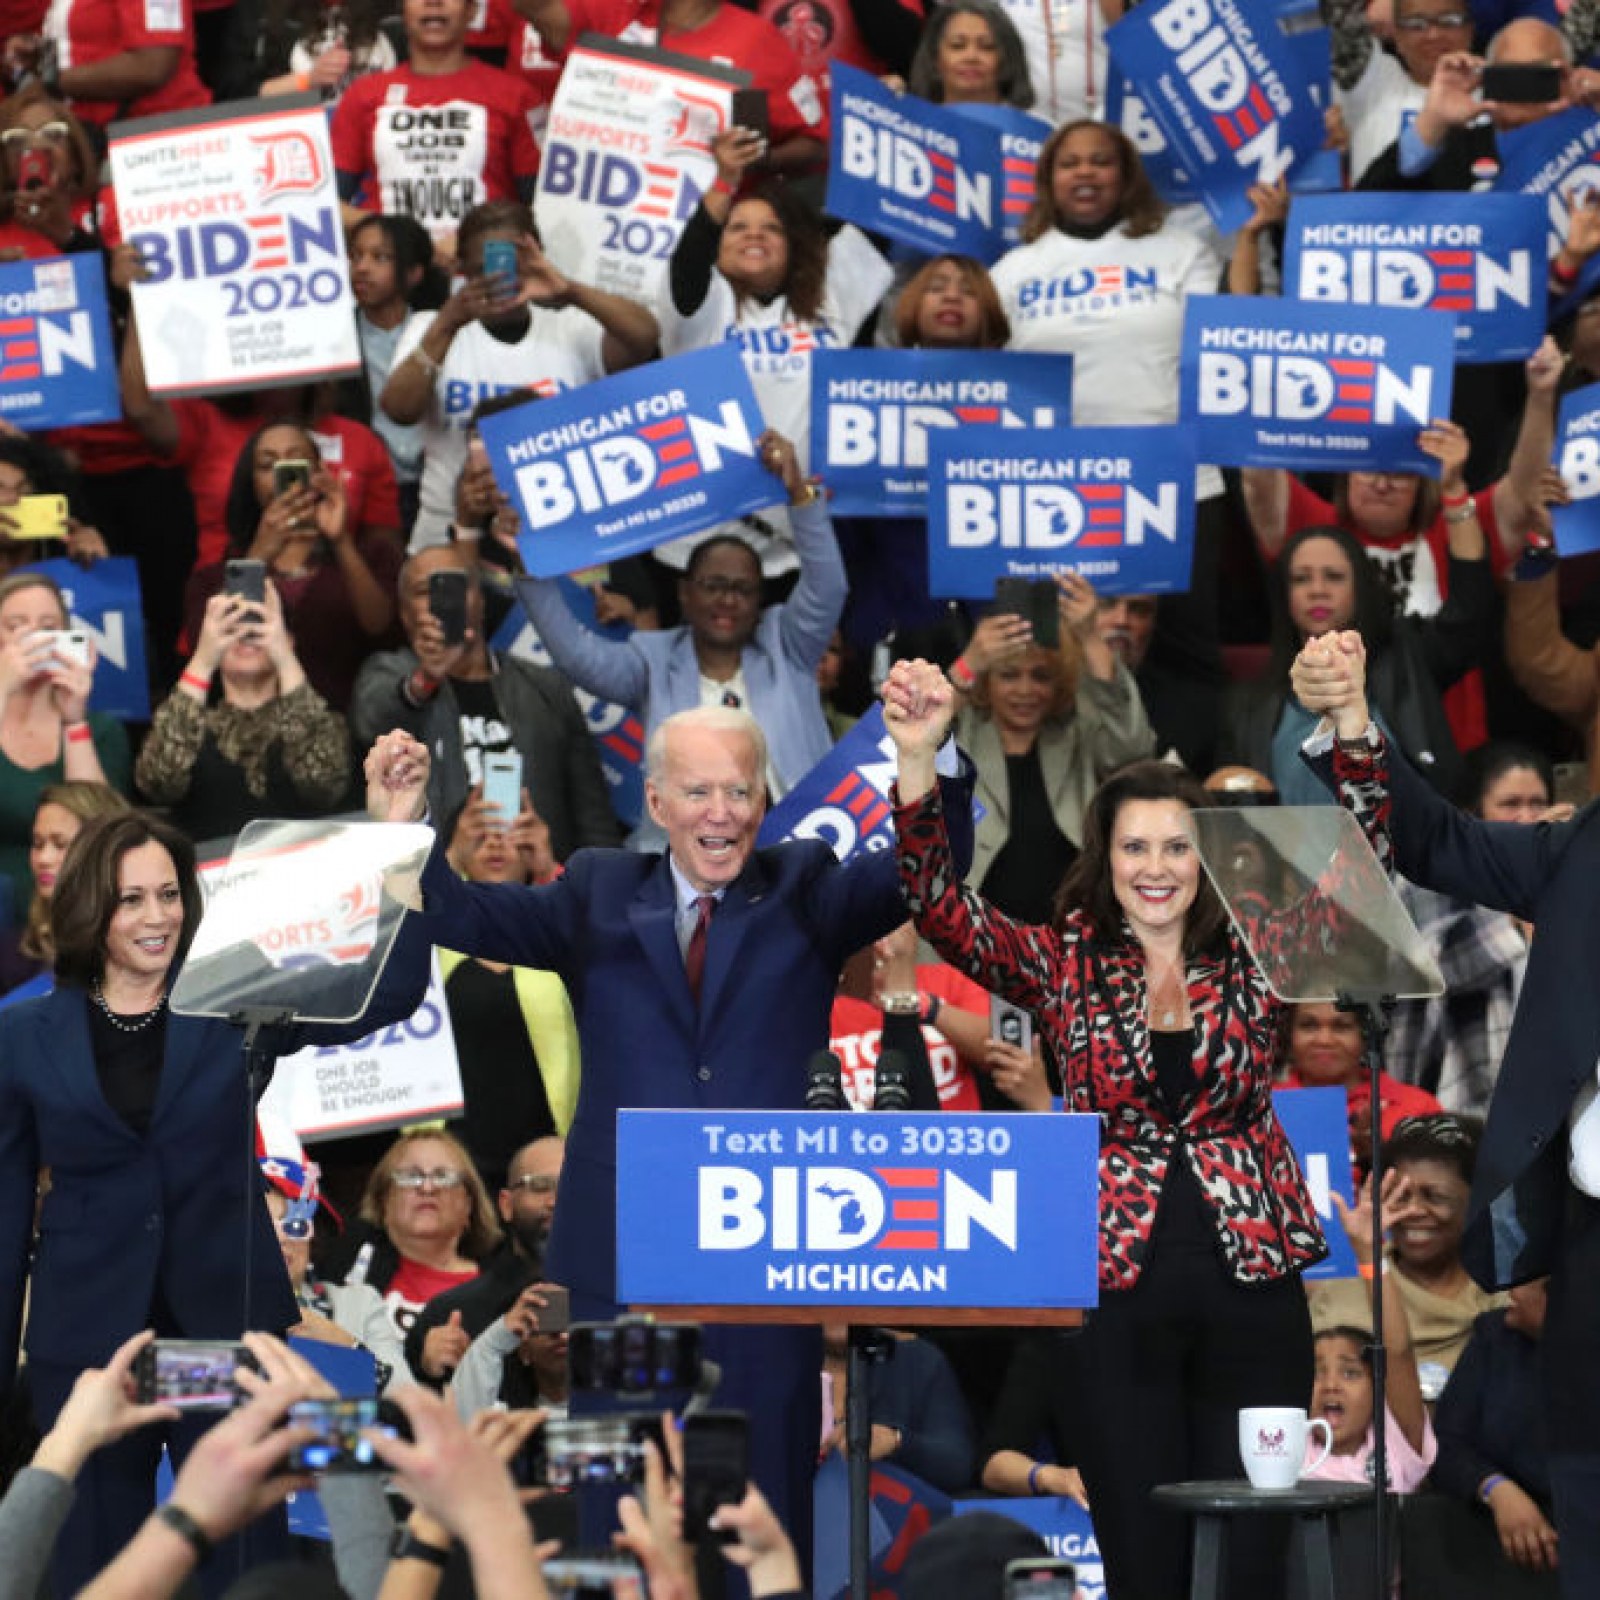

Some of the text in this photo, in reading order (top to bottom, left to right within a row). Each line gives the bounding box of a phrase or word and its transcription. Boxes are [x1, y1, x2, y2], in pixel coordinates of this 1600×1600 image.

[390, 109, 471, 131] ONE
[842, 93, 925, 138] MICHIGAN
[396, 134, 465, 150] JOB
[842, 114, 992, 229] BIDEN
[124, 192, 247, 228] SUPPORTS
[130, 206, 338, 286] BIDEN
[601, 213, 676, 260] 202
[1303, 224, 1483, 246] MICHIGAN FOR
[220, 268, 342, 316] 2020
[1018, 264, 1157, 308] BIDEN
[1299, 249, 1532, 311] BIDEN
[1200, 326, 1386, 357] MICHIGAN FOR
[828, 379, 1008, 402] MICHIGAN FOR
[1198, 351, 1433, 426] BIDEN
[506, 389, 688, 465] MICHIGAN FOR
[514, 399, 755, 530] BIDEN
[946, 457, 1132, 480] MICHIGAN FOR
[947, 481, 1178, 549] BIDEN
[703, 1125, 1011, 1156] Text MI to 30330
[698, 1166, 1018, 1253] BIDEN
[766, 1264, 947, 1292] MICHIGAN
